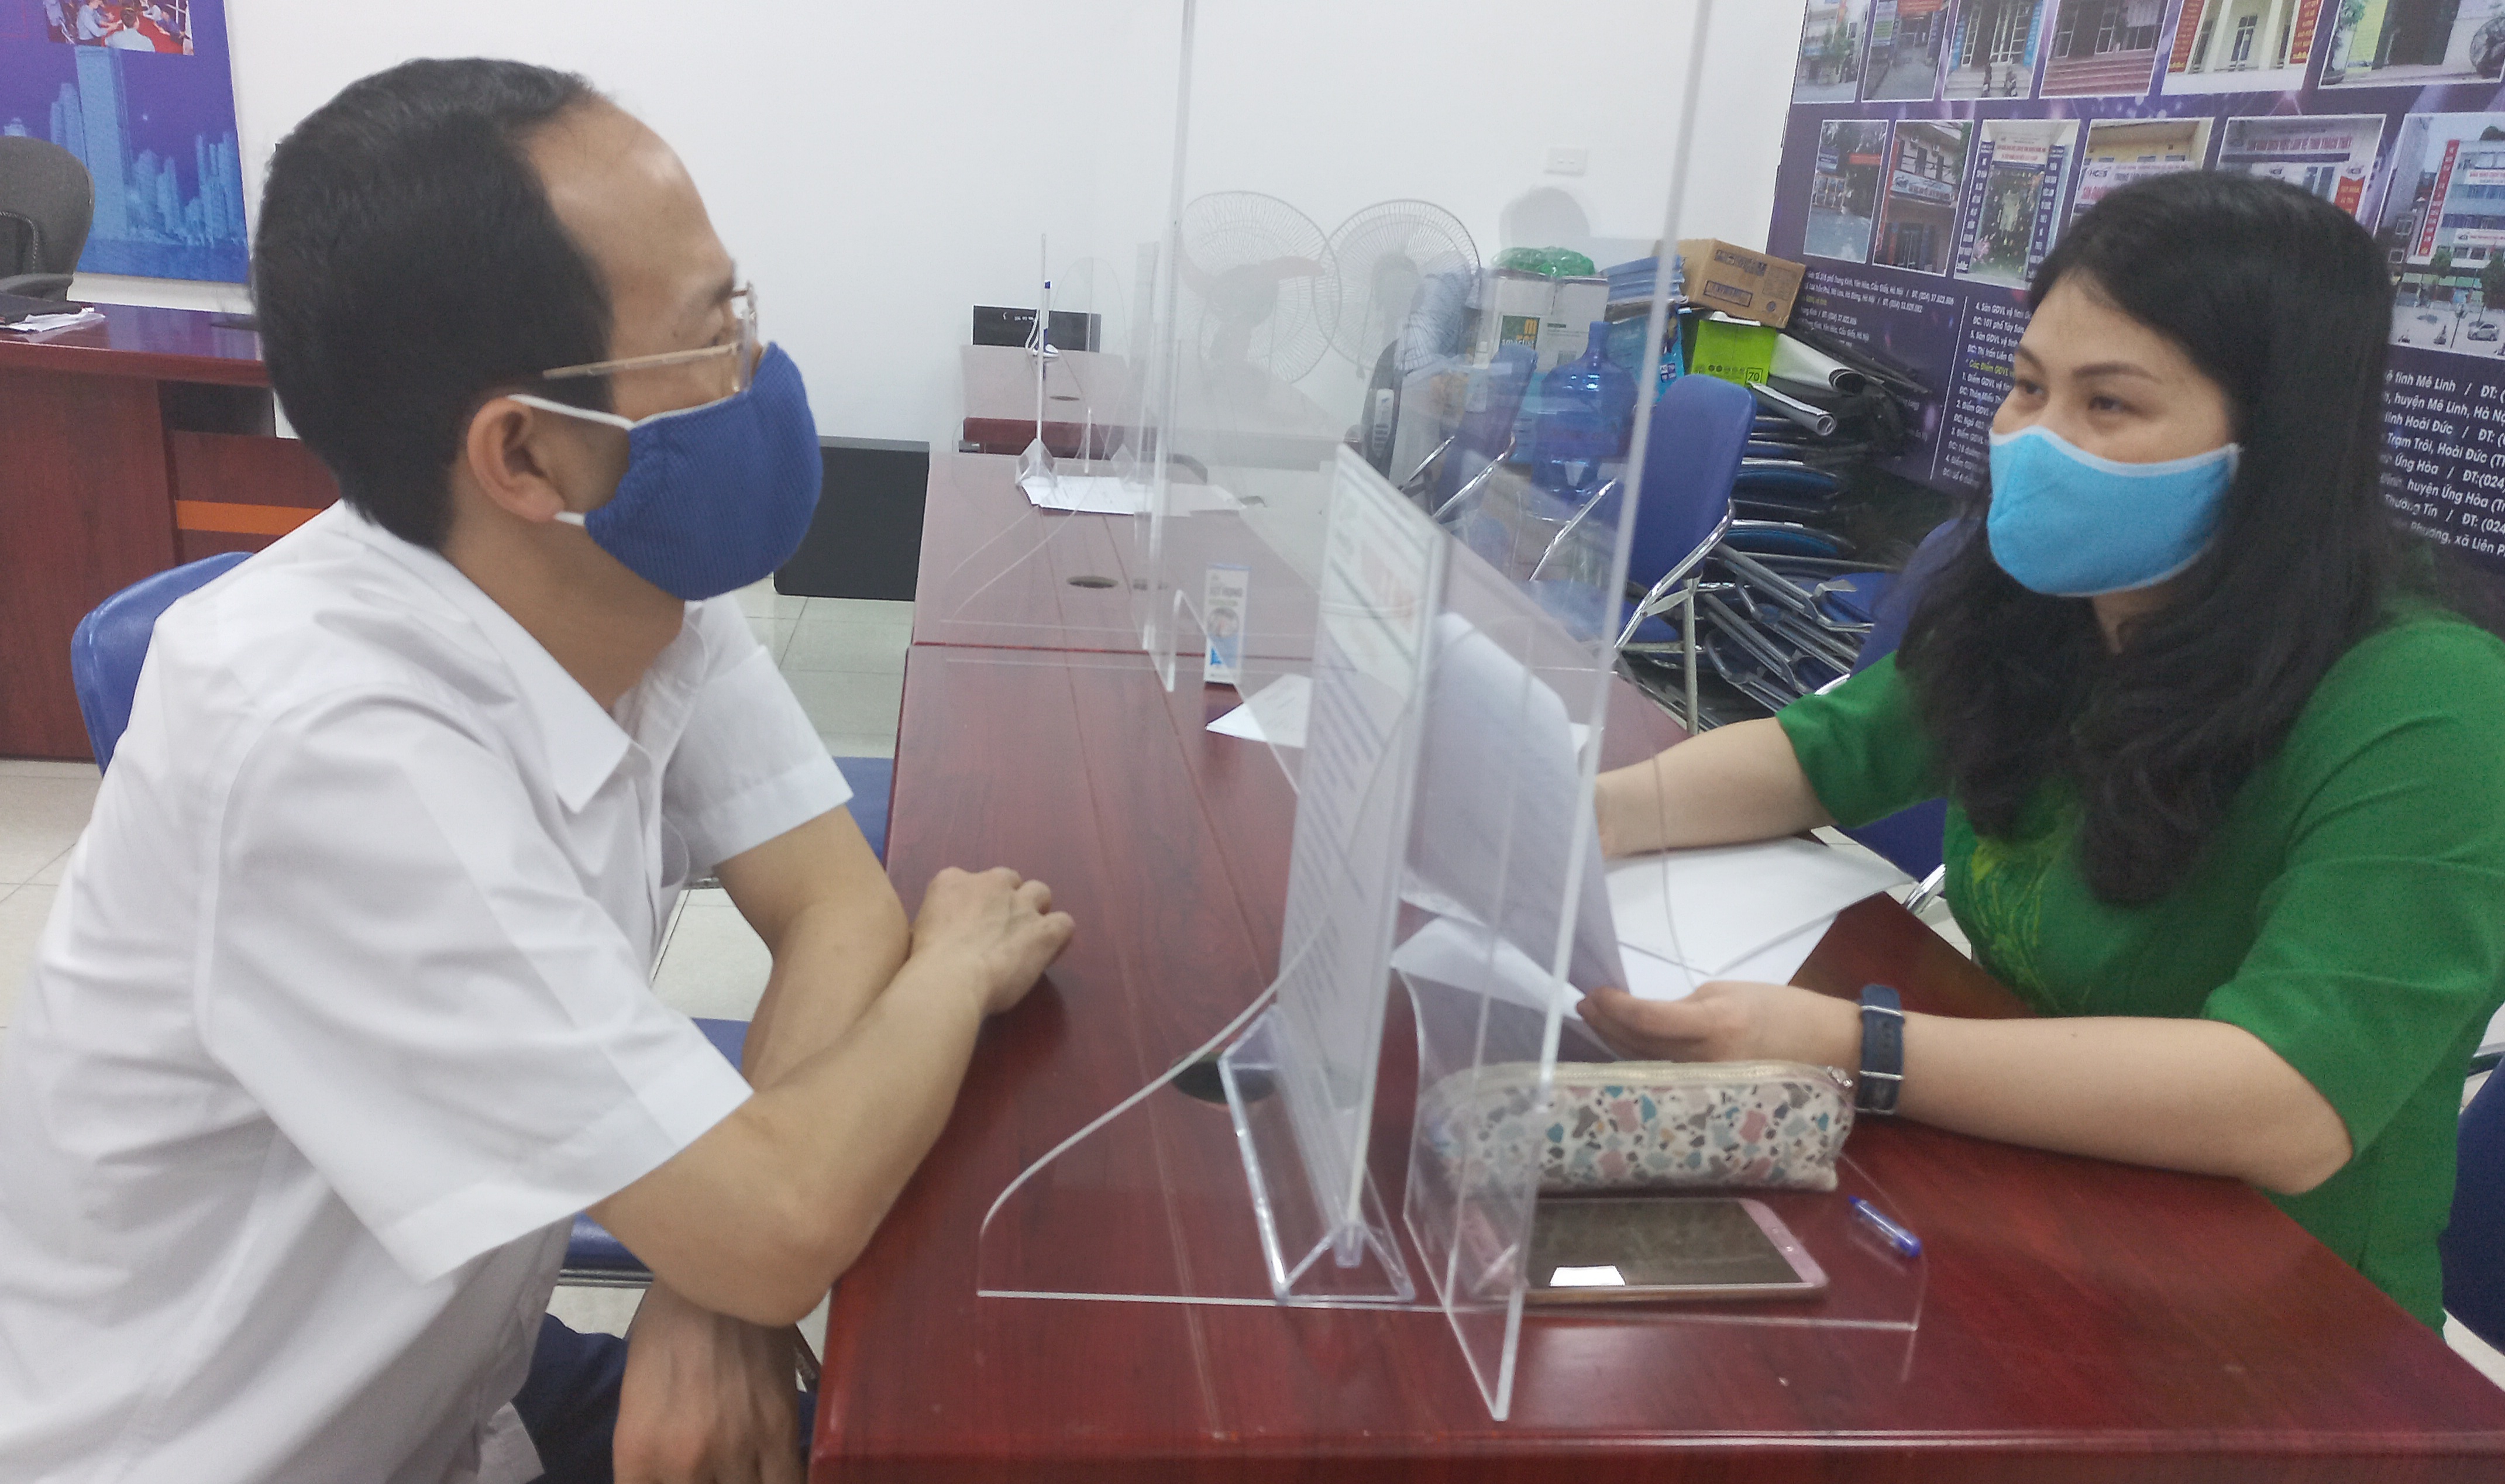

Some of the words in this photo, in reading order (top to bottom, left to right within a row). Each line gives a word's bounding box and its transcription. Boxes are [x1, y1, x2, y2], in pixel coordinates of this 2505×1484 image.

[1748, 372, 1760, 381] 70
[2434, 378, 2456, 392] Linh
[2480, 384, 2498, 399] ĐT:
[2394, 392, 2425, 411] huyện
[2427, 398, 2444, 412] Mê
[2446, 401, 2470, 419] Linh,
[2473, 405, 2490, 419] Hà
[2405, 415, 2430, 431] Hoài
[2432, 419, 2454, 435] Đức
[2478, 428, 2495, 443] ĐT:
[2387, 432, 2411, 449] Trạm
[2437, 442, 2463, 459] Hoài
[2465, 447, 2488, 463] Đức
[2394, 452, 2415, 472] Ứng
[2416, 459, 2439, 475] Hòa
[2407, 478, 2439, 497] huyện
[2441, 484, 2463, 505] Ứng
[2465, 491, 2489, 508] Hòa
[2423, 502, 2437, 517] Tín
[2462, 512, 2479, 526] ĐT:
[2454, 534, 2469, 547] xã
[2472, 537, 2494, 553] Liên
